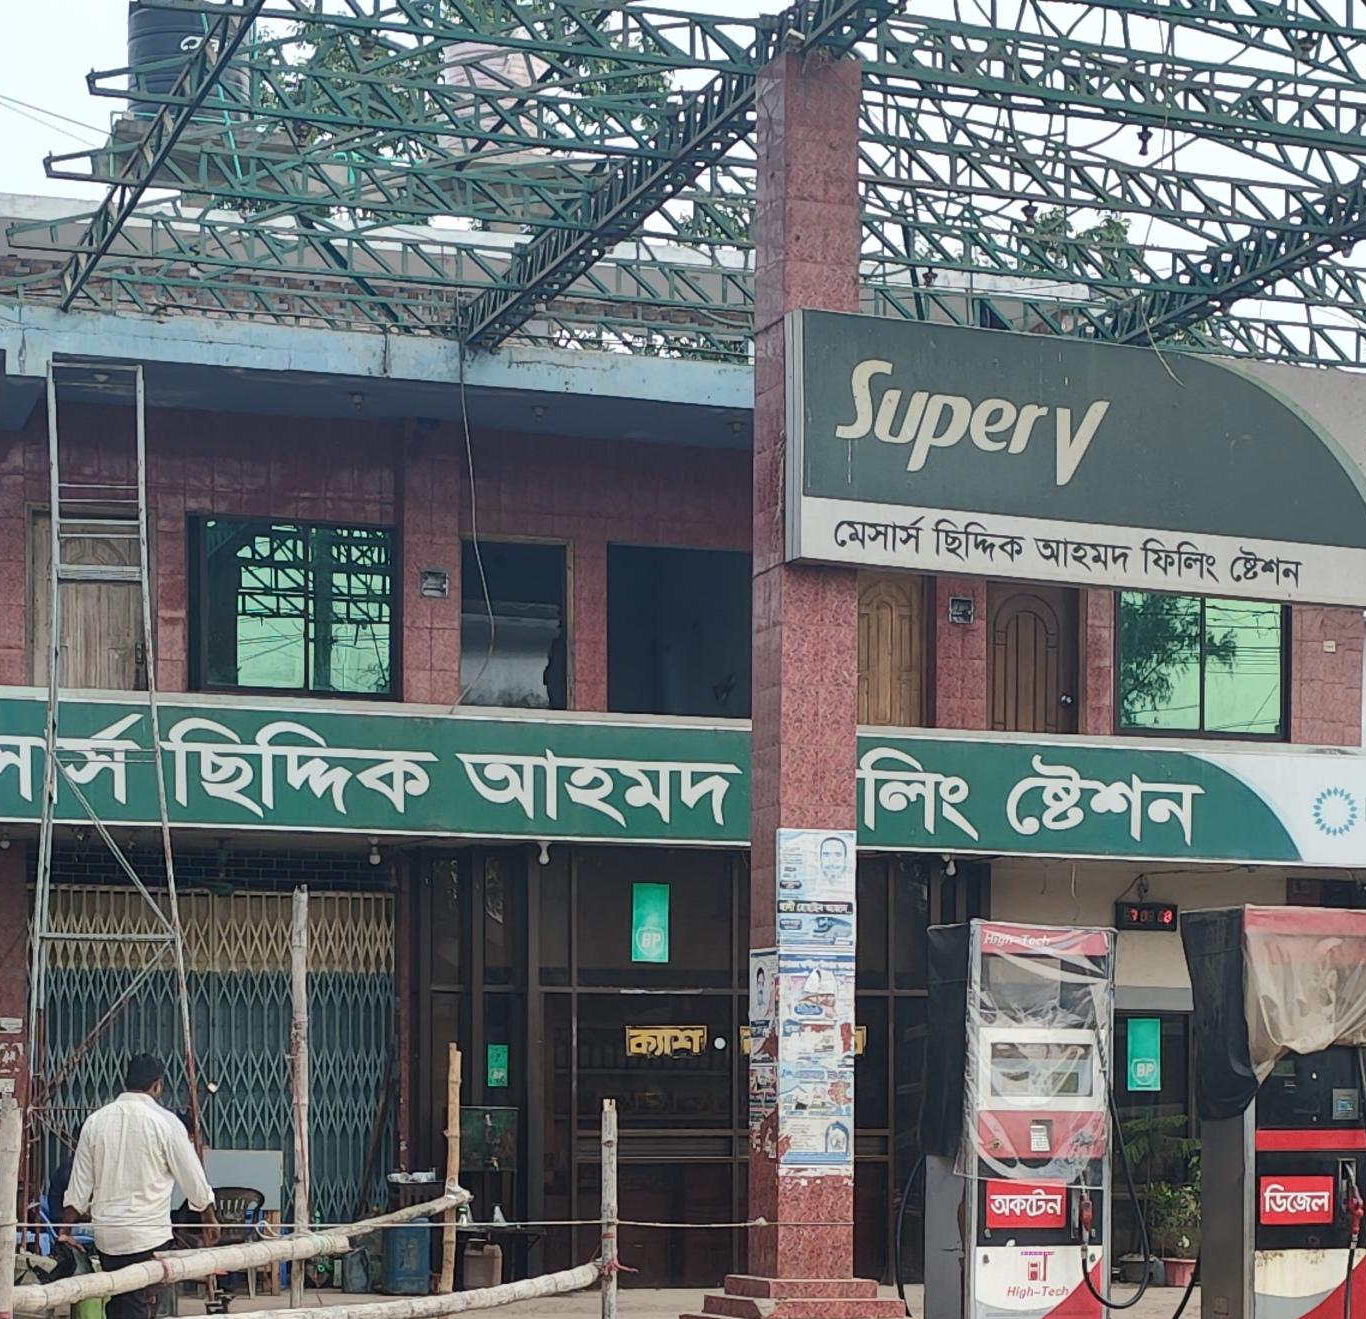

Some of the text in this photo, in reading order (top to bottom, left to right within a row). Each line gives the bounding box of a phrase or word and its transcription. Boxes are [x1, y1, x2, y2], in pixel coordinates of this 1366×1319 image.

[837, 358, 1048, 471] Super
[833, 516, 922, 552] মেসার্স
[933, 519, 1025, 563] ছিদ্দিক
[1036, 533, 1128, 576] আহমদ
[1141, 540, 1221, 585] ফিলিং
[160, 717, 439, 819] ছিদ্দিক
[455, 748, 743, 828] আহমদ
[857, 748, 980, 841] লিং
[641, 932, 663, 949] BP
[629, 1028, 703, 1057] ক্যাশ
[1136, 1063, 1156, 1077] BP
[990, 1190, 1063, 1216] অকটেন
[1264, 1184, 1331, 1213] ডিজেল
[1006, 1286, 1070, 1300] High-Tech
